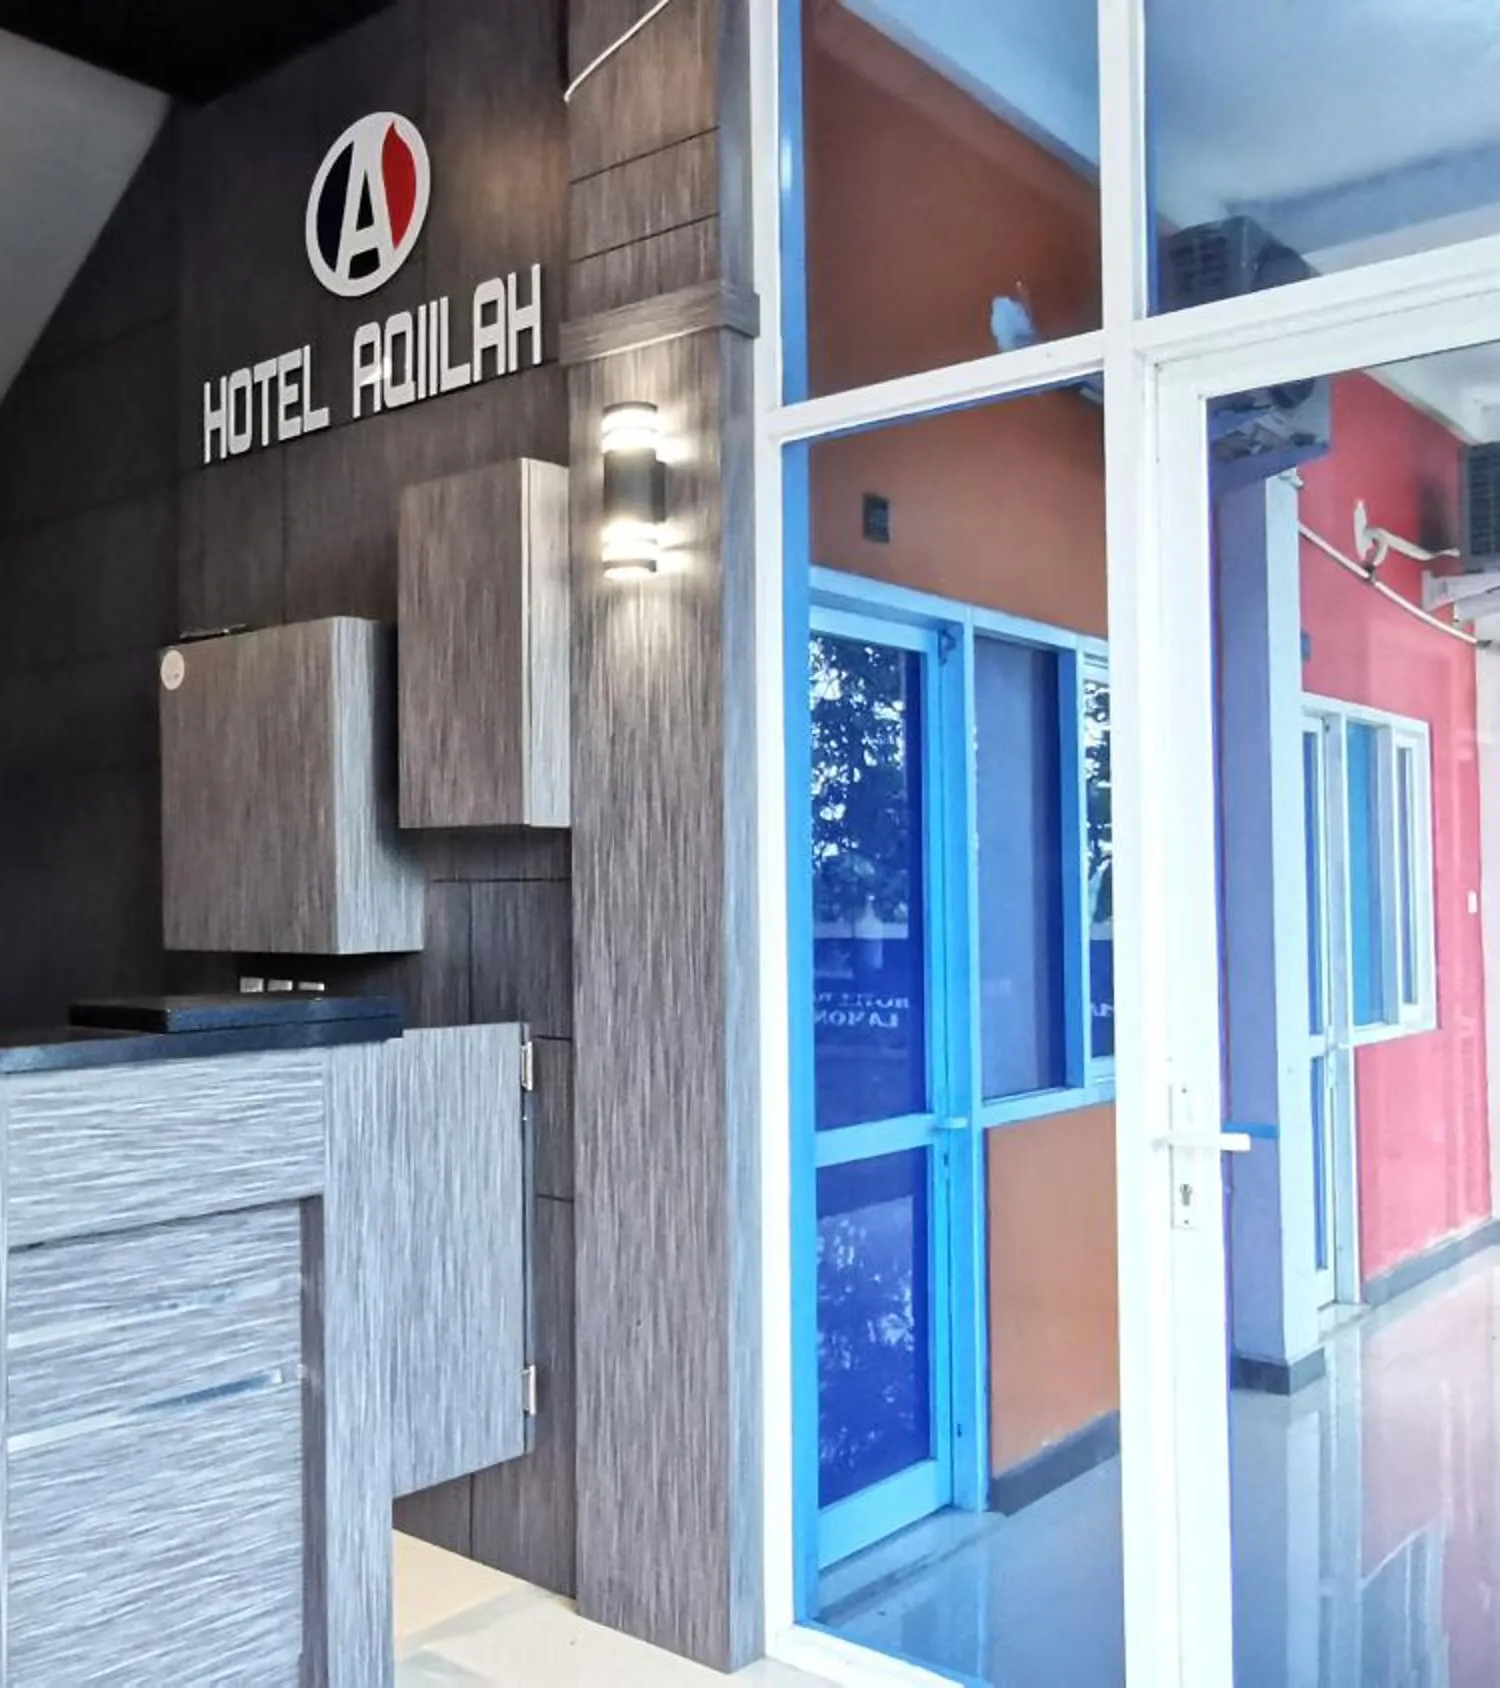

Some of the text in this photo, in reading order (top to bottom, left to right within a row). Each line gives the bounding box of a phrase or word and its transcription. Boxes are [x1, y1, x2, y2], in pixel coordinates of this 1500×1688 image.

[329, 114, 402, 290] A
[204, 263, 542, 464] HOTEL AQIILAH
